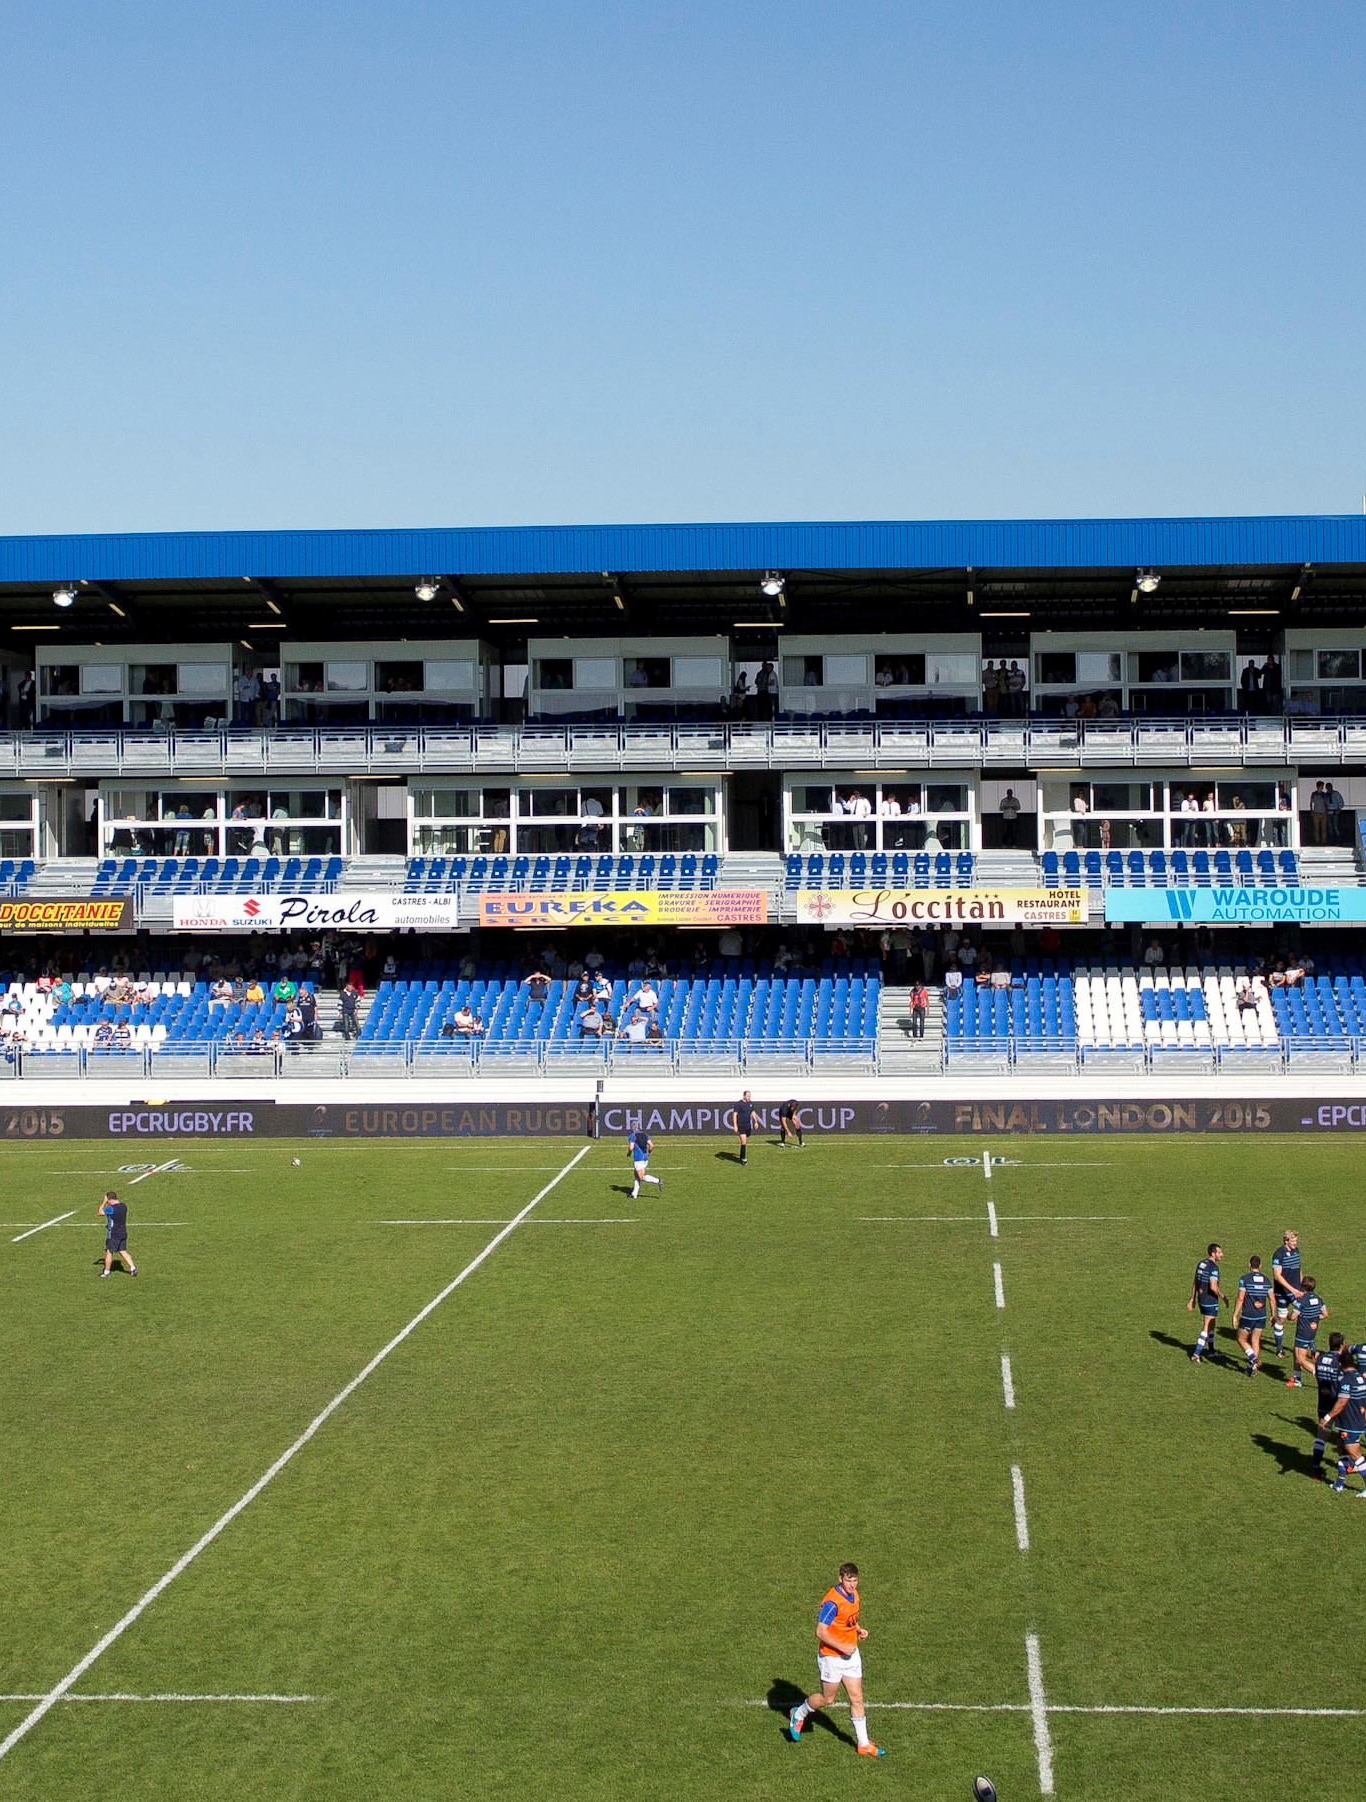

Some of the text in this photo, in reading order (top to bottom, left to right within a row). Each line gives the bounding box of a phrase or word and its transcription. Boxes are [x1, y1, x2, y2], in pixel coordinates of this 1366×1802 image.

[392, 898, 427, 906] CASTRES
[1017, 900, 1081, 908] RESTAURANT
[1212, 890, 1340, 905] WAROUDE
[279, 897, 379, 925] Pirola
[485, 900, 650, 914] EUREKA
[1212, 907, 1341, 919] AUTOMATION
[180, 918, 228, 926] HONDA
[232, 918, 273, 926] SUZUKI
[394, 916, 451, 924] automobiles
[717, 914, 763, 922] CASTRES
[1024, 911, 1067, 920] CASTRES
[4, 1110, 66, 1135] 2015
[108, 1112, 253, 1133] EPCRUGBY.FR
[345, 1109, 594, 1132] EUROPEAN RUGBY
[798, 1108, 856, 1130] CUP
[955, 1103, 1272, 1130] FINAL LONDON 2015
